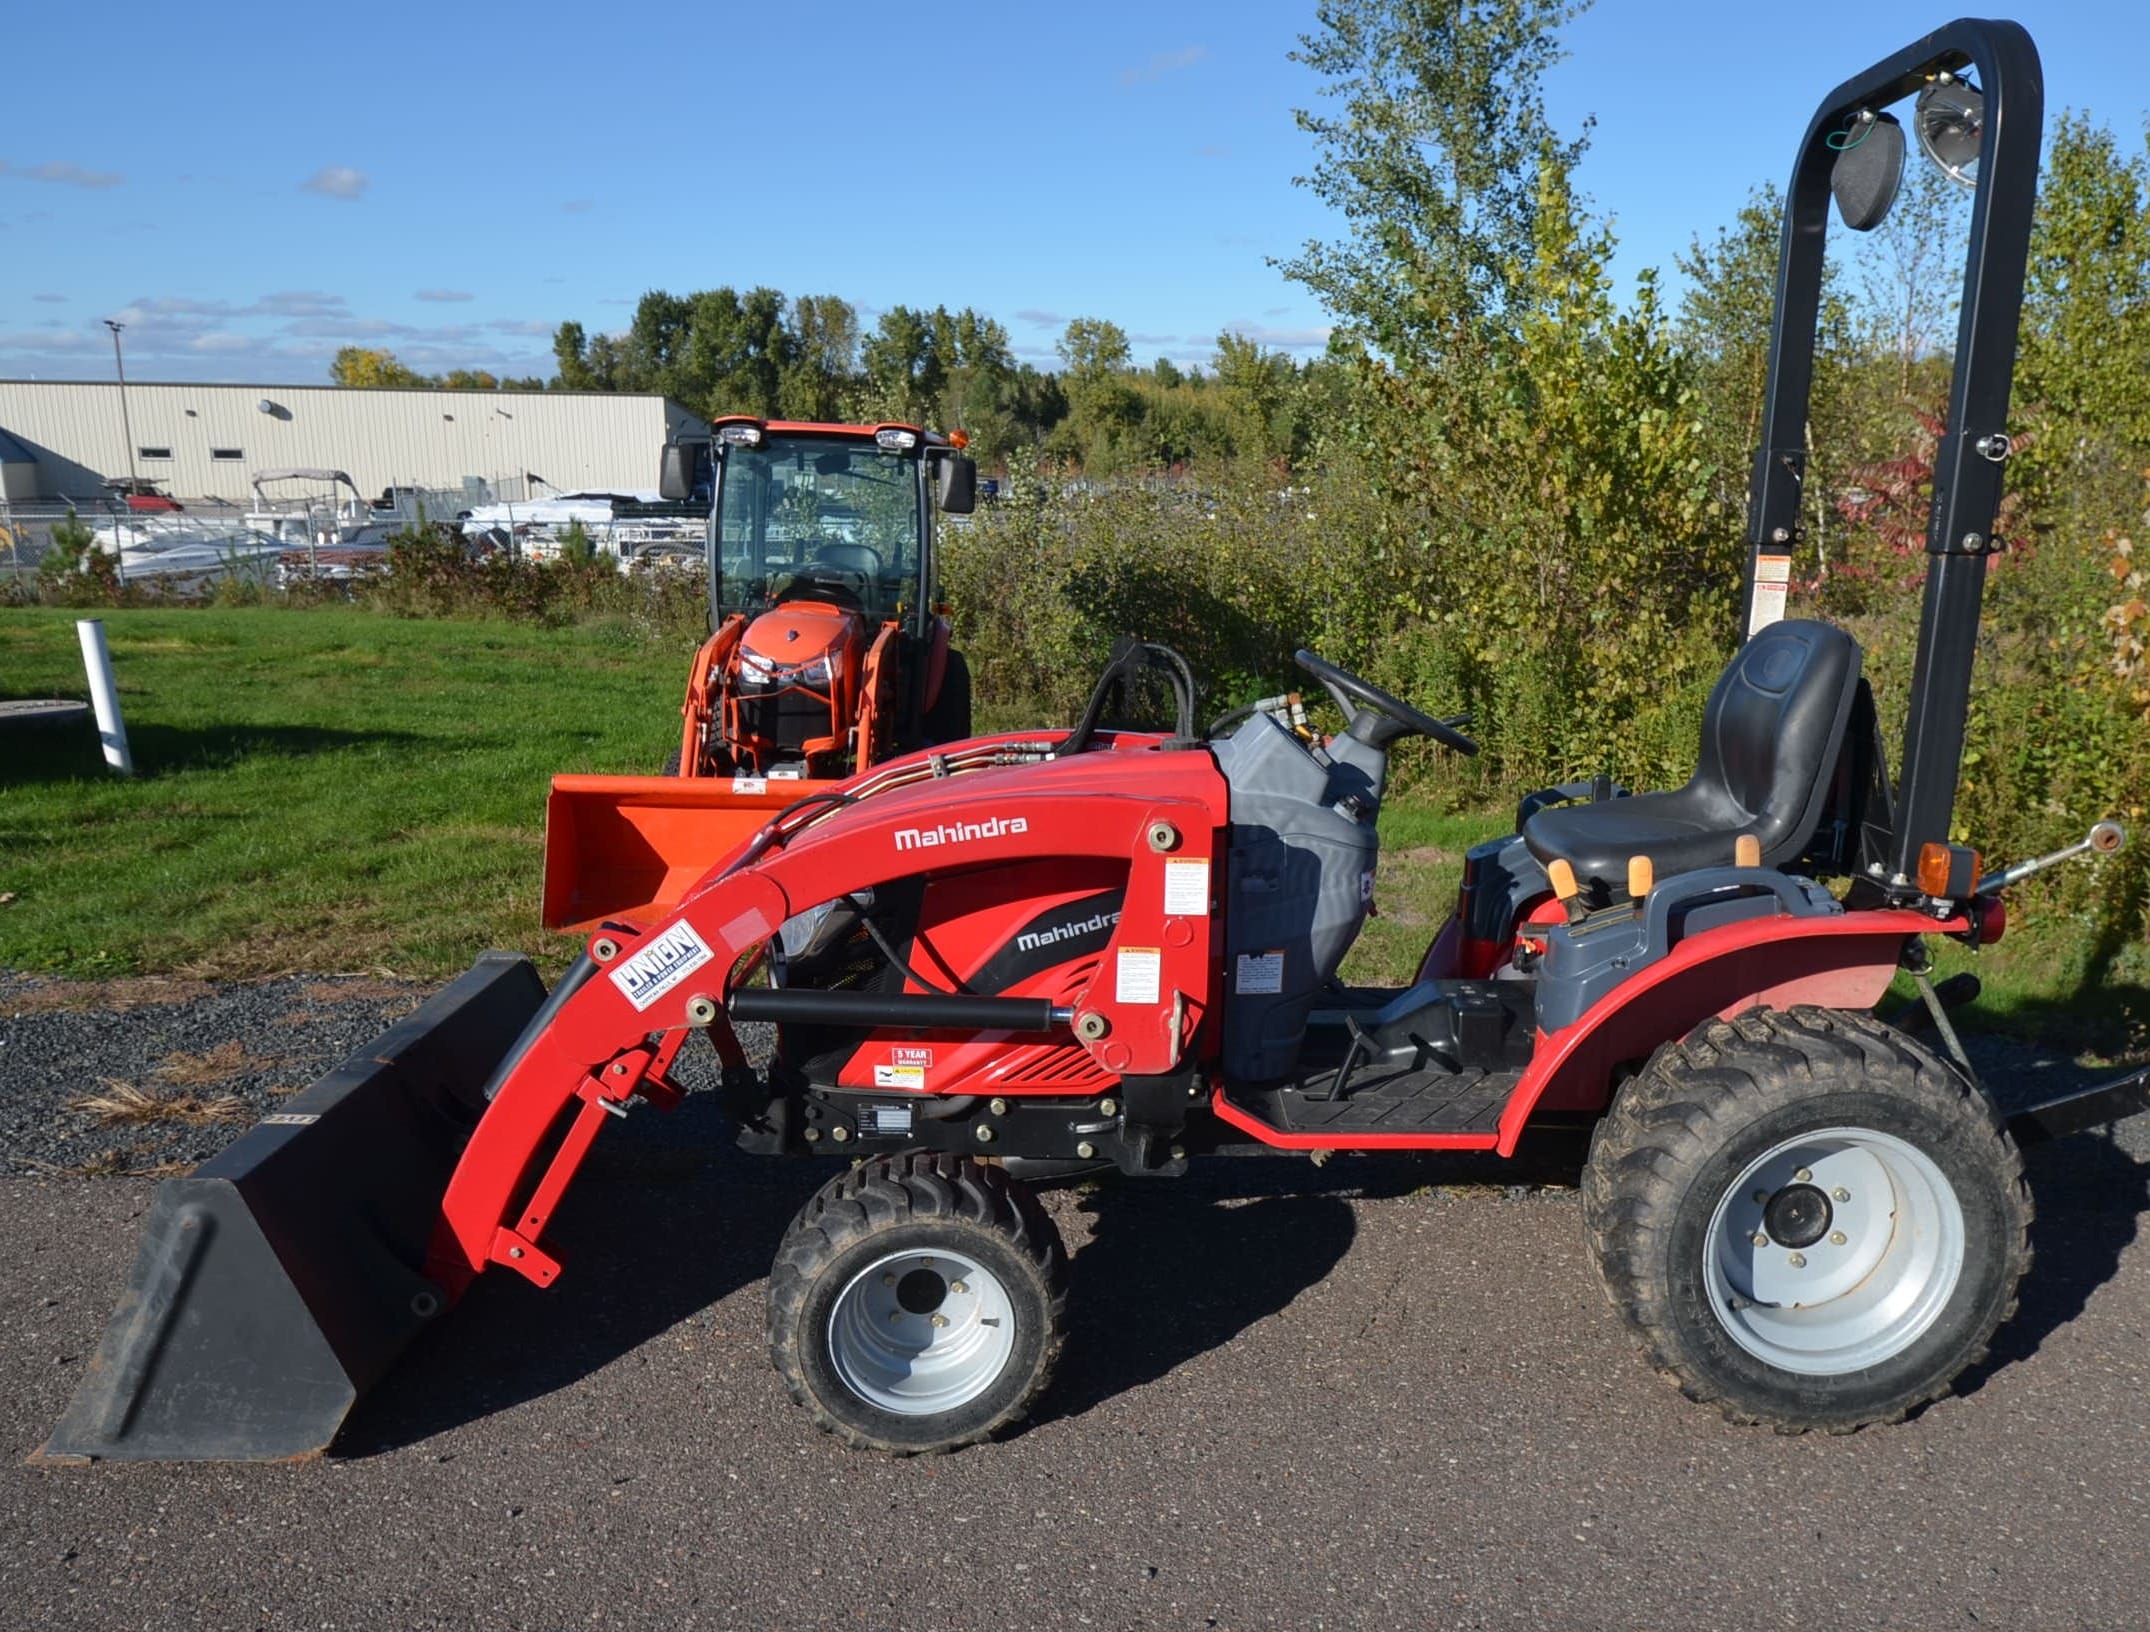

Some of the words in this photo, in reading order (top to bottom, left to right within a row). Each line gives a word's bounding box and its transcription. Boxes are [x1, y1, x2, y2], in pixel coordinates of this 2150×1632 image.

[894, 817, 1027, 850] Mahindra
[1017, 912, 1121, 951] Mahindra
[897, 1050, 903, 1058] 5
[905, 1050, 926, 1058] YEAR
